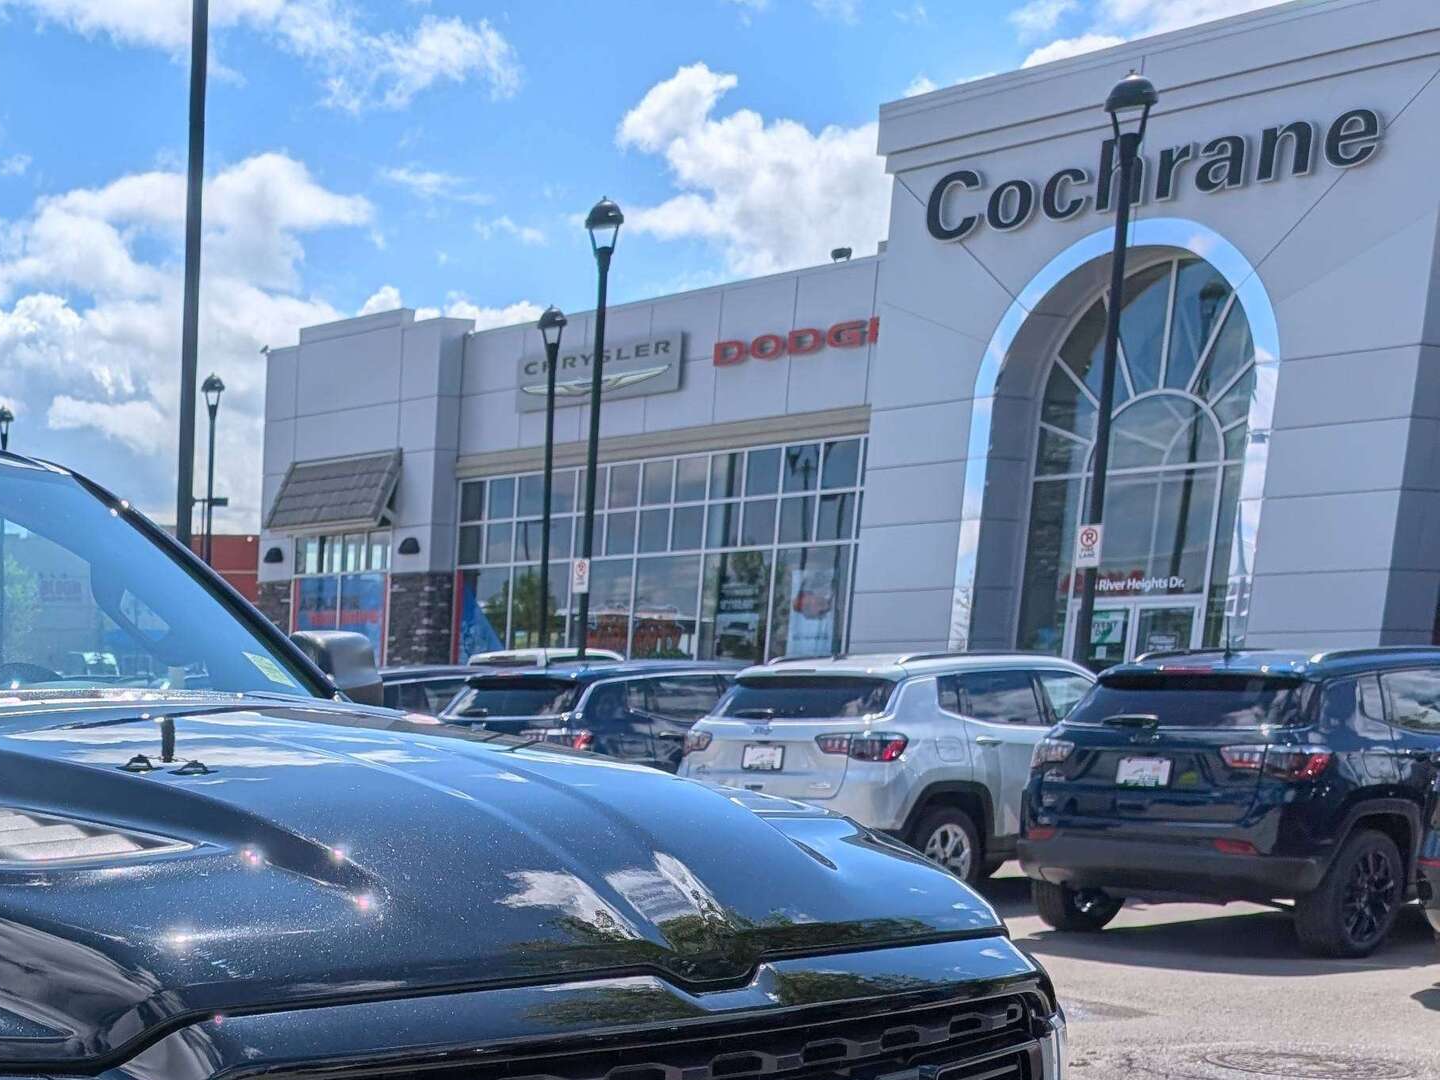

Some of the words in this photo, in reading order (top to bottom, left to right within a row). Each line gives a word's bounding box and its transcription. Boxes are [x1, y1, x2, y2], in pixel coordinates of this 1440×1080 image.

[926, 108, 1383, 243] Cochrane
[1098, 578, 1126, 592] River
[1127, 576, 1168, 593] Heights
[1169, 575, 1185, 589] Dr.
